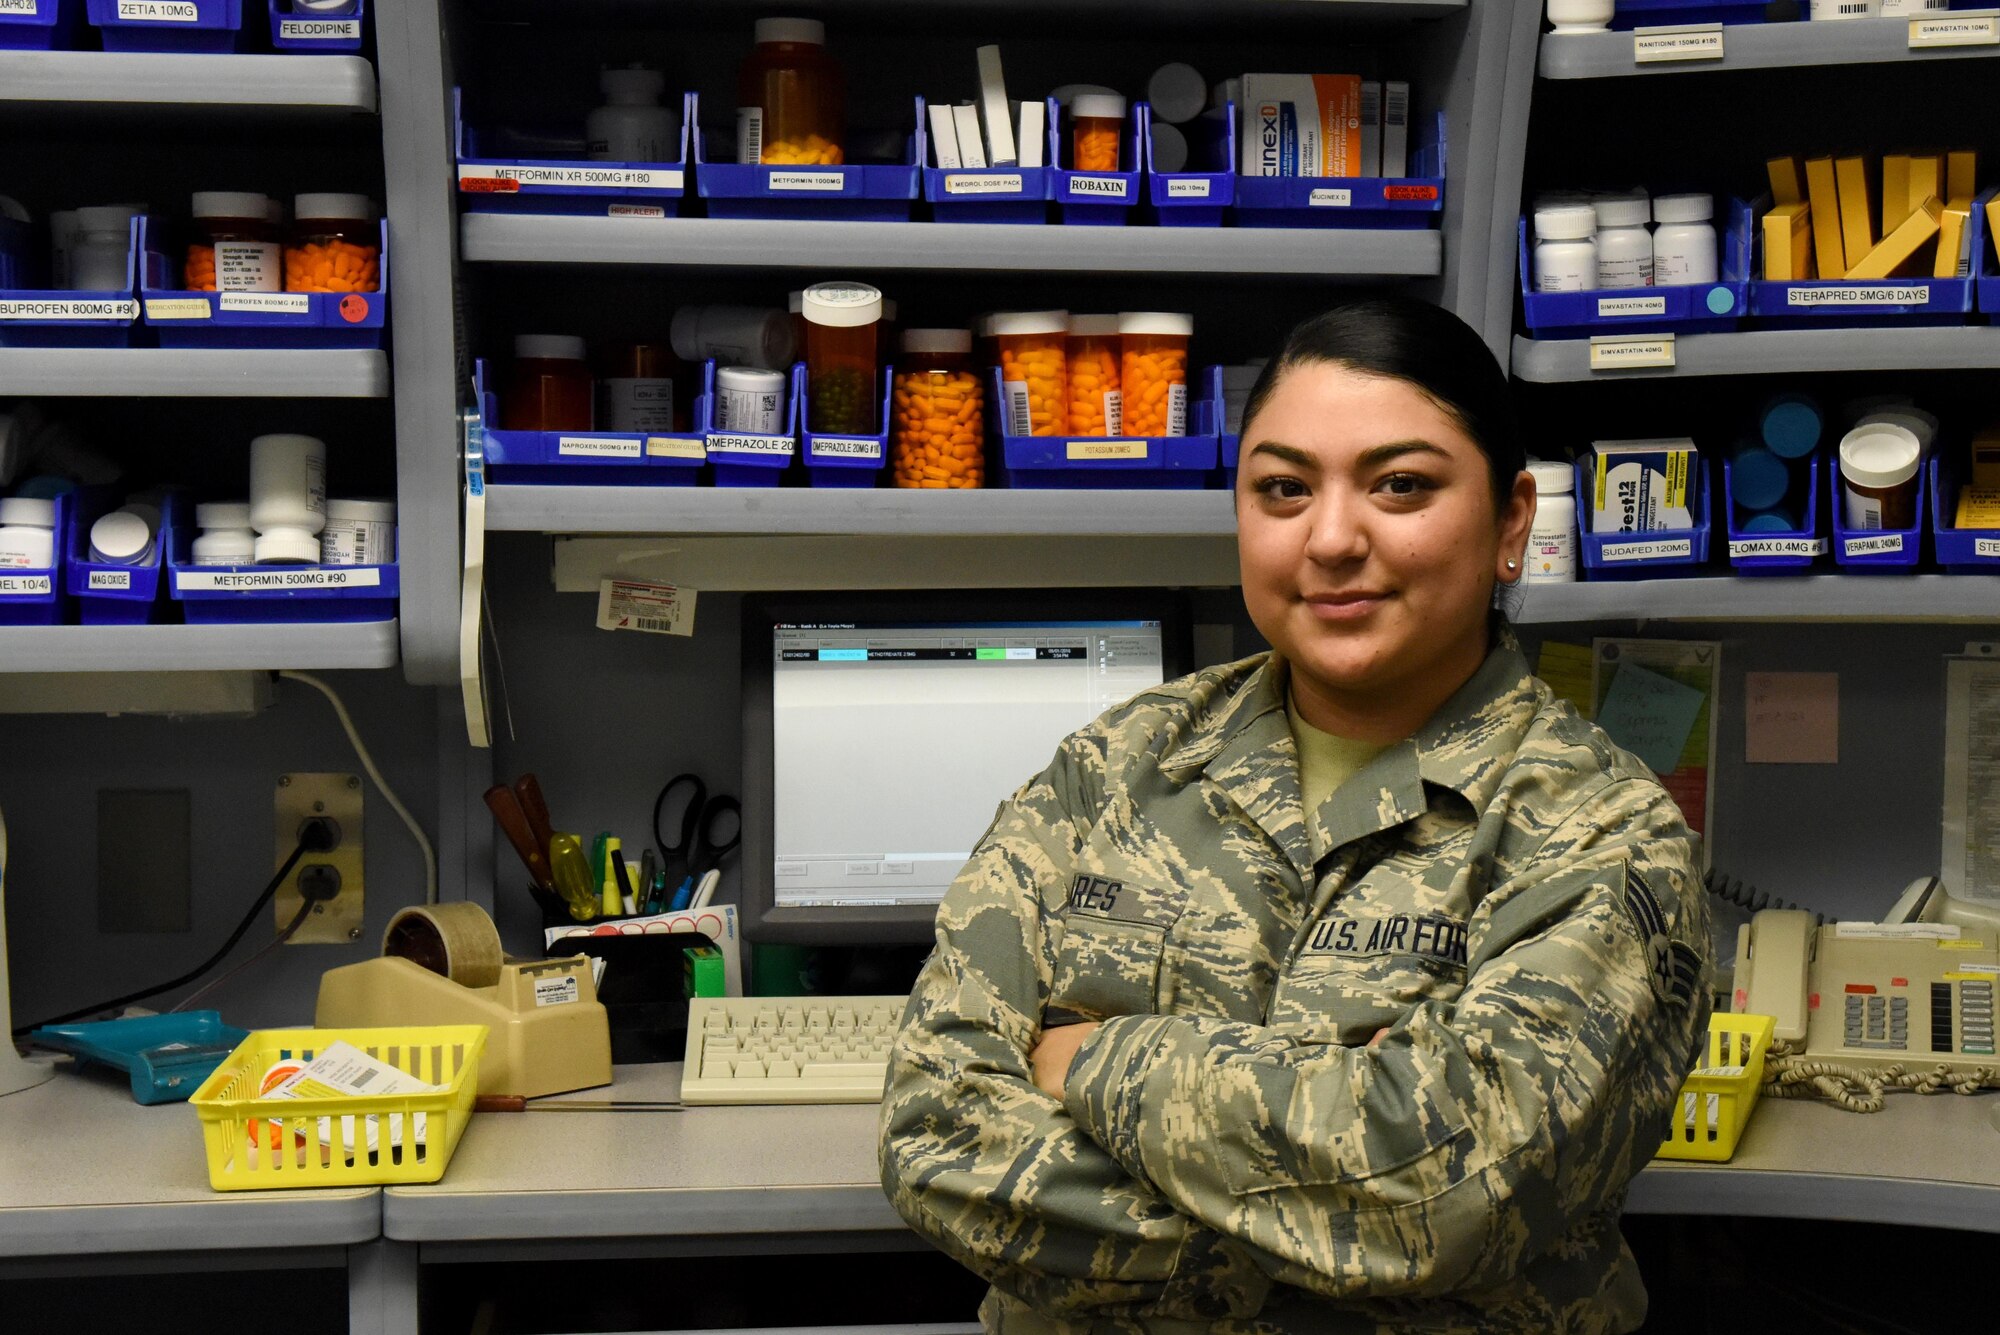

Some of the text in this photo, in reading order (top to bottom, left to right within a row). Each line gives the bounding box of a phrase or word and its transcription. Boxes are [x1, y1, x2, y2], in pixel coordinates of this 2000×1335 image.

[121, 4, 193, 16] ZETIA 10MG
[283, 24, 352, 34] FELODIPINE
[1639, 40, 1676, 48] RANITIDINE
[495, 170, 650, 183] METFORMIN XR 500MG #180
[1071, 179, 1124, 192] ROBAXIN
[1312, 192, 1340, 200] MUCINEX
[634, 208, 661, 216] ALERT
[1790, 289, 1927, 301] STERAPRED 5MG/6 DAYS
[72, 304, 113, 314] 800MG
[706, 438, 778, 450] OMEPRAZOLE
[813, 442, 851, 453] OMEPRAZOLE
[852, 443, 869, 453] 20MG
[1085, 446, 1113, 454] POTASSIUM
[1678, 456, 1686, 489] NON-DROWSY
[1532, 533, 1567, 541] Simvastatin
[1603, 544, 1689, 557] SUDAFED 120MG
[1729, 542, 1773, 554] FLOMAX
[1775, 542, 1809, 553] 0.4MG
[1846, 538, 1901, 552] VERAPAMIL 240MG
[91, 575, 128, 585] MAG OXIDE
[214, 573, 346, 586] METFORMIN 500MG #90
[1311, 920, 1359, 952] U.S.
[1364, 916, 1410, 953] AIR
